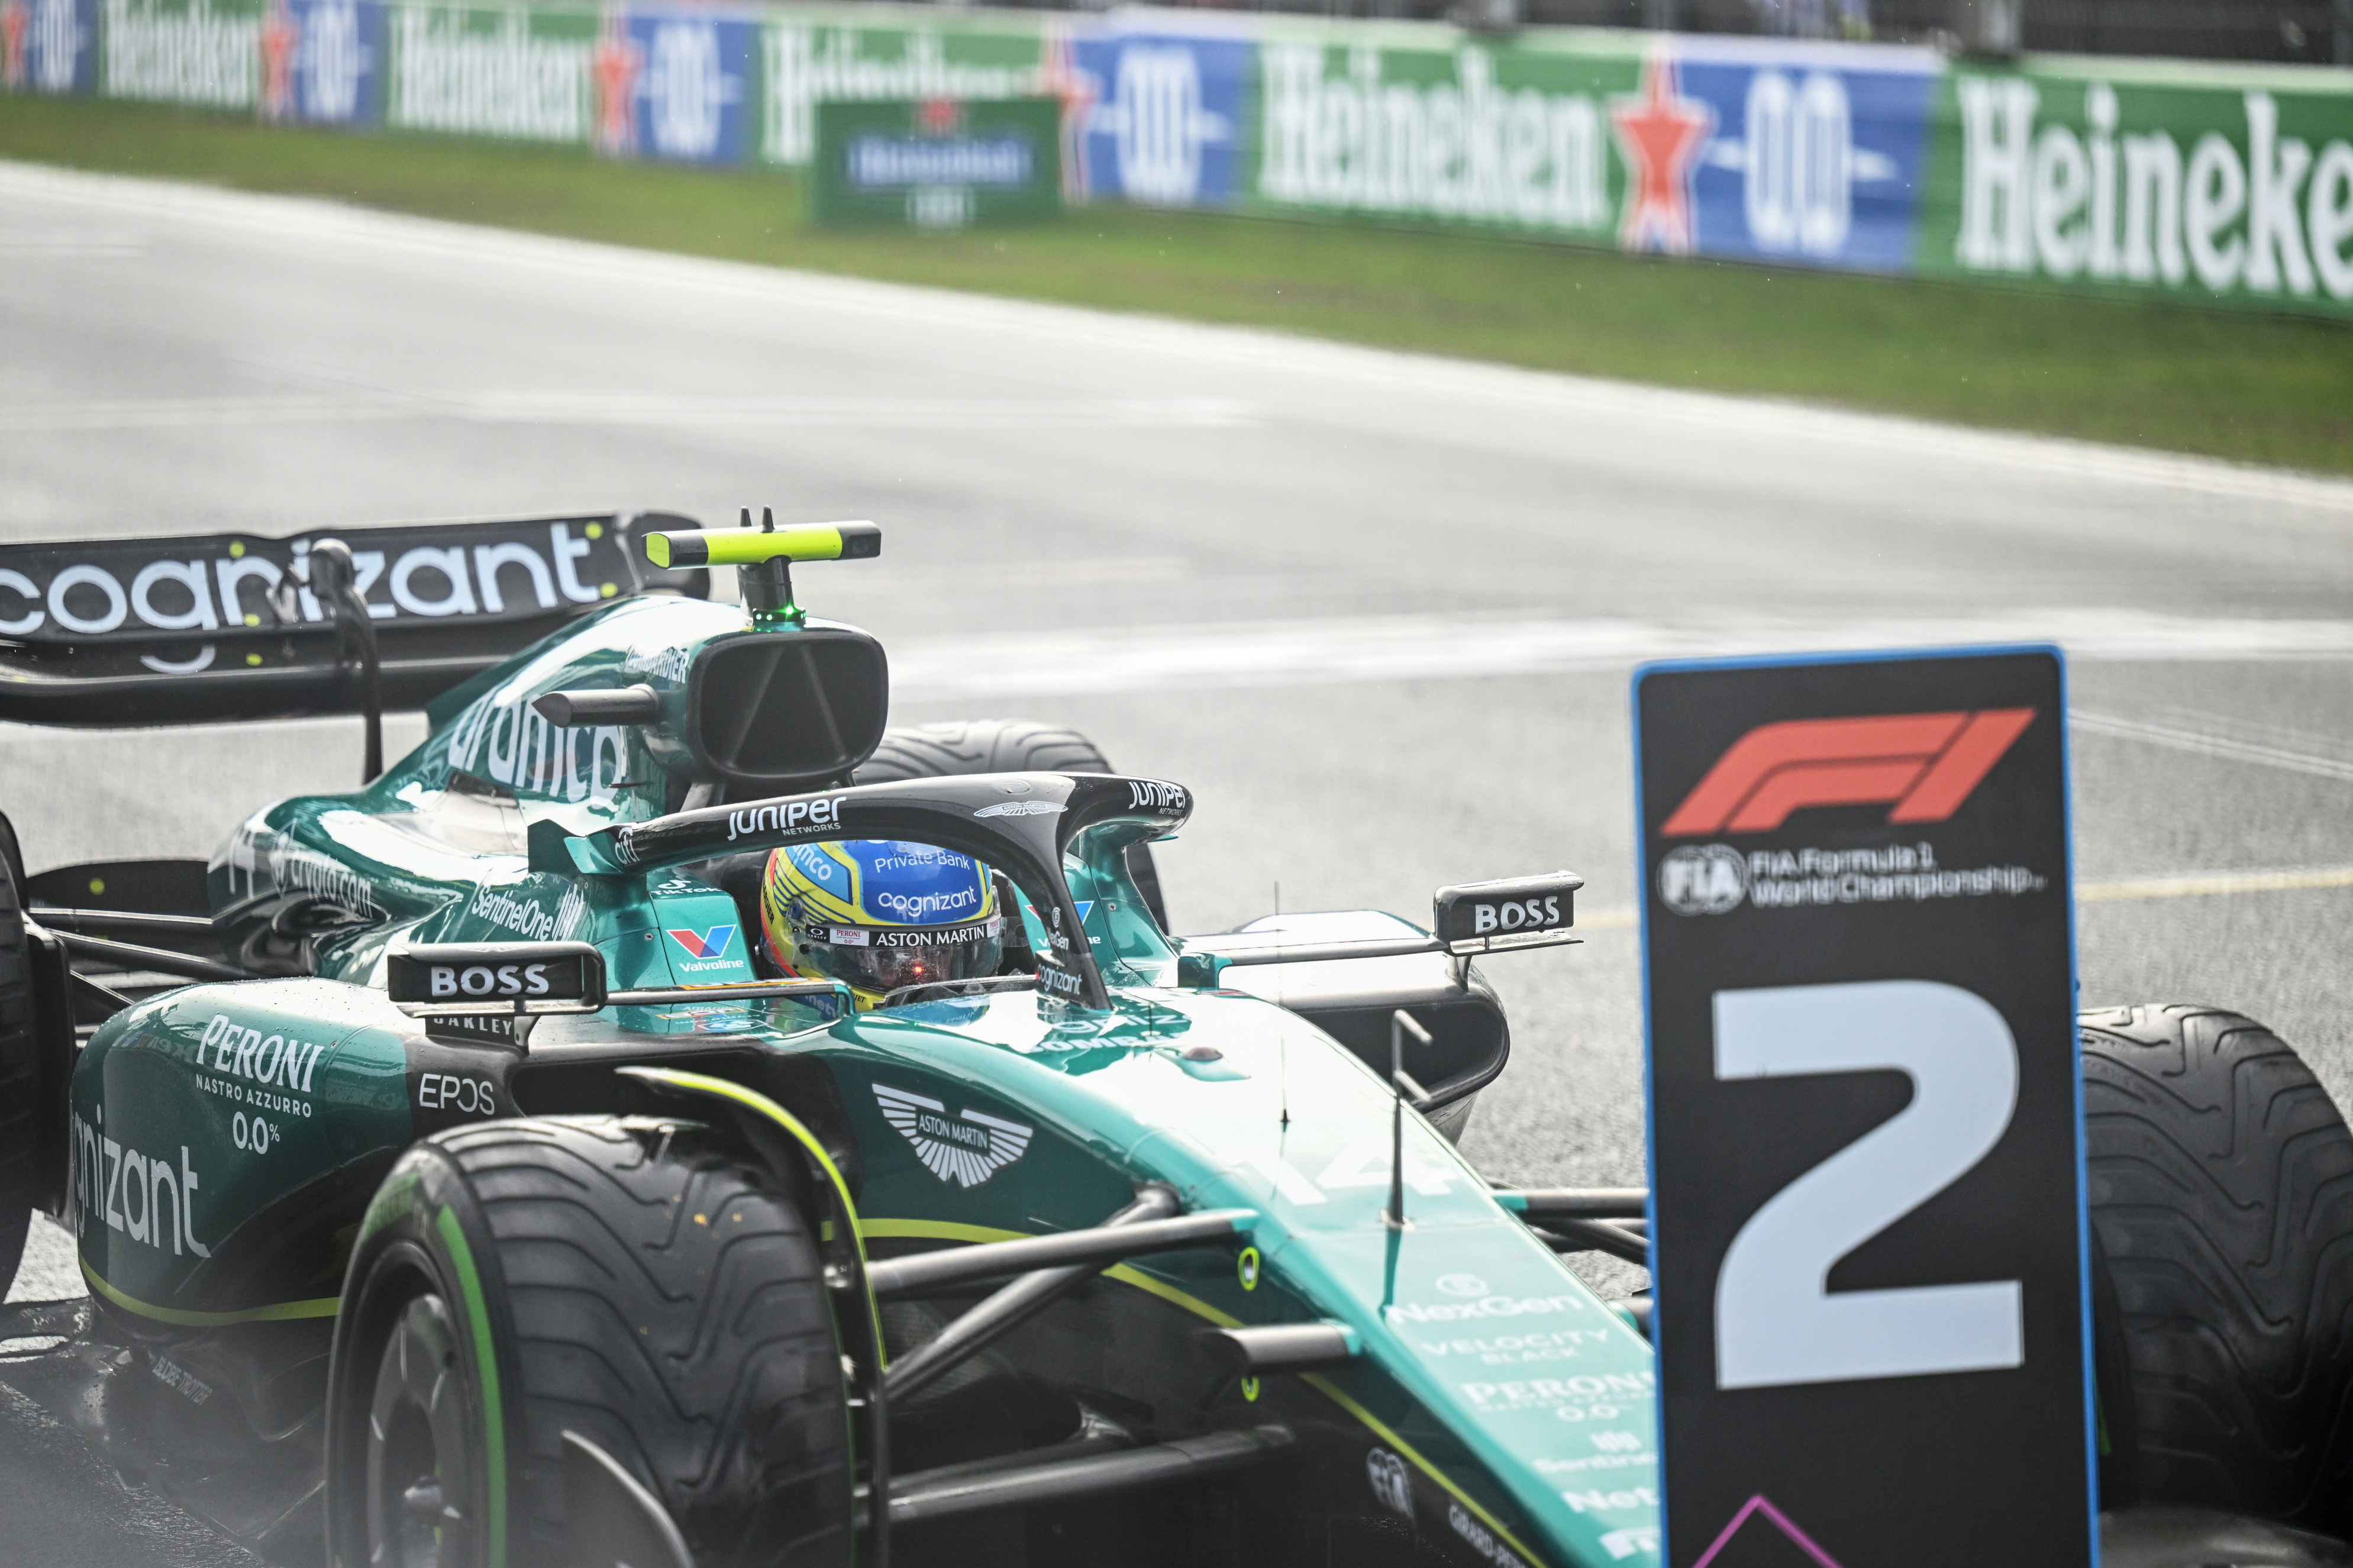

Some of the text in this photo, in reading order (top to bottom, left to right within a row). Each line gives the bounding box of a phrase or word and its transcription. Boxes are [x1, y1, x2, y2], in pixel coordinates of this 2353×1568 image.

[1259, 39, 1612, 229] Heineken
[1158, 807, 1183, 816] NETWORKS
[782, 822, 841, 836] NETWORKS
[874, 850, 970, 873] Private Bank
[650, 887, 722, 895] TikTok
[472, 884, 554, 942] SentinelOne
[1474, 895, 1560, 935] BOSS
[837, 929, 861, 937] PERONI
[876, 925, 985, 946] ASTON MARTIN
[431, 964, 550, 997] BOSS
[679, 959, 744, 972] Valvoline
[1038, 964, 1083, 995] cognizant
[196, 1014, 325, 1093] PERONI
[196, 1074, 312, 1118] NASTRO AZZURRO
[418, 1073, 495, 1116] EPOS
[233, 1111, 280, 1155] 0.0%
[918, 1114, 987, 1149] ASTON MARTIN
[1712, 979, 2025, 1391] 2
[1420, 1328, 1609, 1357] VELOCITY
